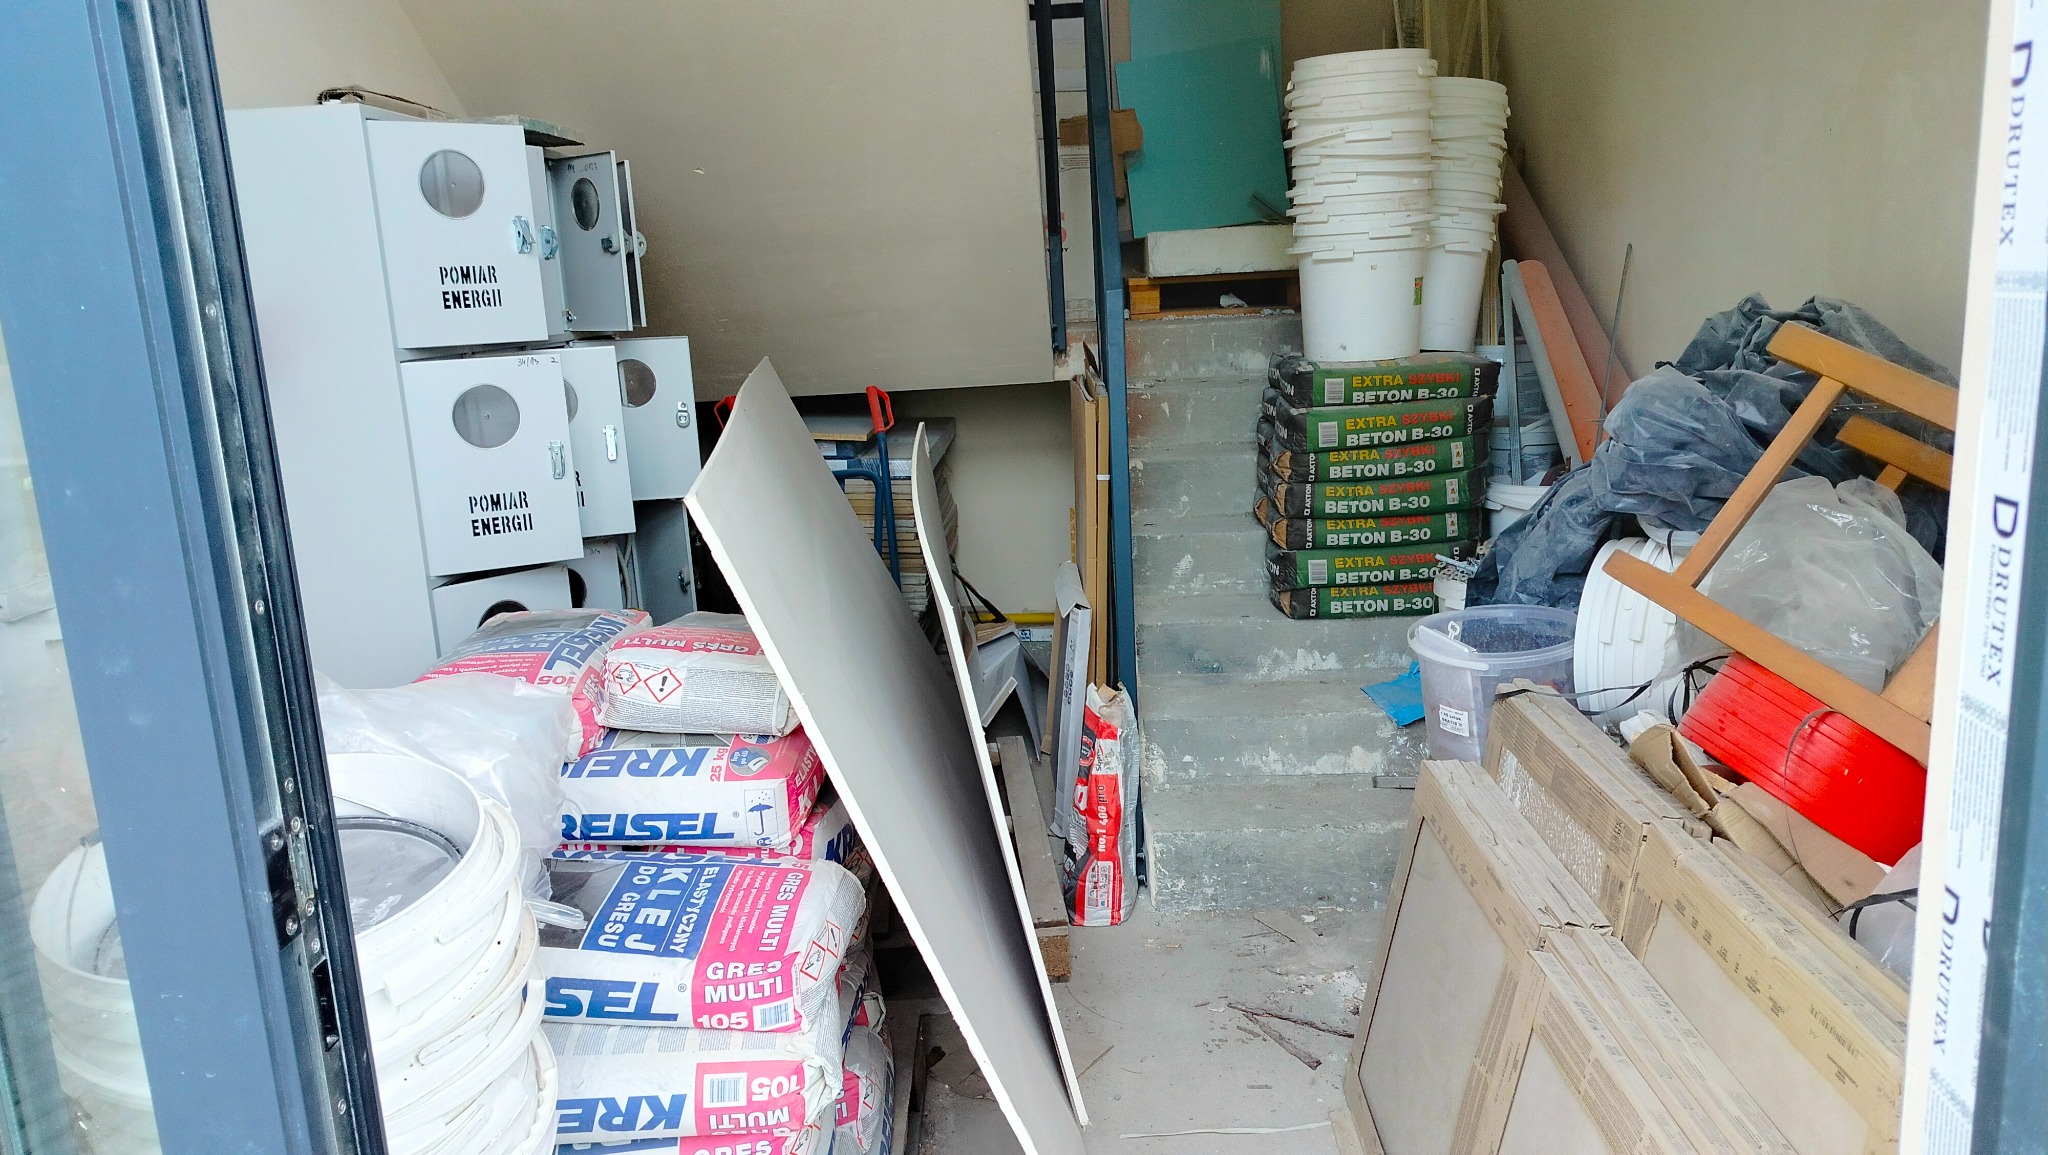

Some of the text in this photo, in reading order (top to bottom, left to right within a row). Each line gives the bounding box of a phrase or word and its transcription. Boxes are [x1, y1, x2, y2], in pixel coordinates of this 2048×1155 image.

[1999, 94, 2026, 246] DRUTEX
[439, 265, 498, 285] POMIAR
[442, 288, 502, 310] ENERGII
[1352, 373, 1461, 388] EXTRA SZYBKI
[1352, 387, 1459, 403] BETON B-30
[1345, 410, 1454, 430] EXTRA SZYBKI
[1346, 425, 1453, 447] BETON B-30
[1329, 444, 1436, 462] EXTRA SZYBKI
[1329, 460, 1436, 479] BETON B-30
[1325, 481, 1431, 498] EXTRA SZYBKI
[468, 491, 529, 514] POMIAR
[1325, 496, 1431, 514] BETON B-30
[471, 514, 533, 537] ENERGII
[1326, 515, 1431, 530] EXTRA SZYBKI
[1326, 527, 1431, 546] BETON B-30
[1334, 556, 1385, 569] EXTRA
[1335, 566, 1439, 584] BETON B-30
[1330, 586, 1379, 597] EXTRA
[1330, 597, 1433, 614] BETON B-30
[1987, 548, 2013, 688] DRUTEX
[537, 675, 576, 686] 105
[560, 747, 710, 778] KREI
[709, 765, 722, 782] 25
[1098, 785, 1108, 803] pro
[1097, 805, 1109, 826] 400
[776, 872, 805, 901] GRES
[598, 866, 651, 948] DO GRESU
[669, 866, 720, 954] ELASTYCZNY
[759, 904, 790, 952] MULTI
[704, 976, 783, 1004] MULTI
[1933, 930, 1954, 1056] DRUTEX
[697, 1013, 749, 1031] 105
[751, 1074, 801, 1101] 105
[708, 1105, 791, 1130] MULTI
